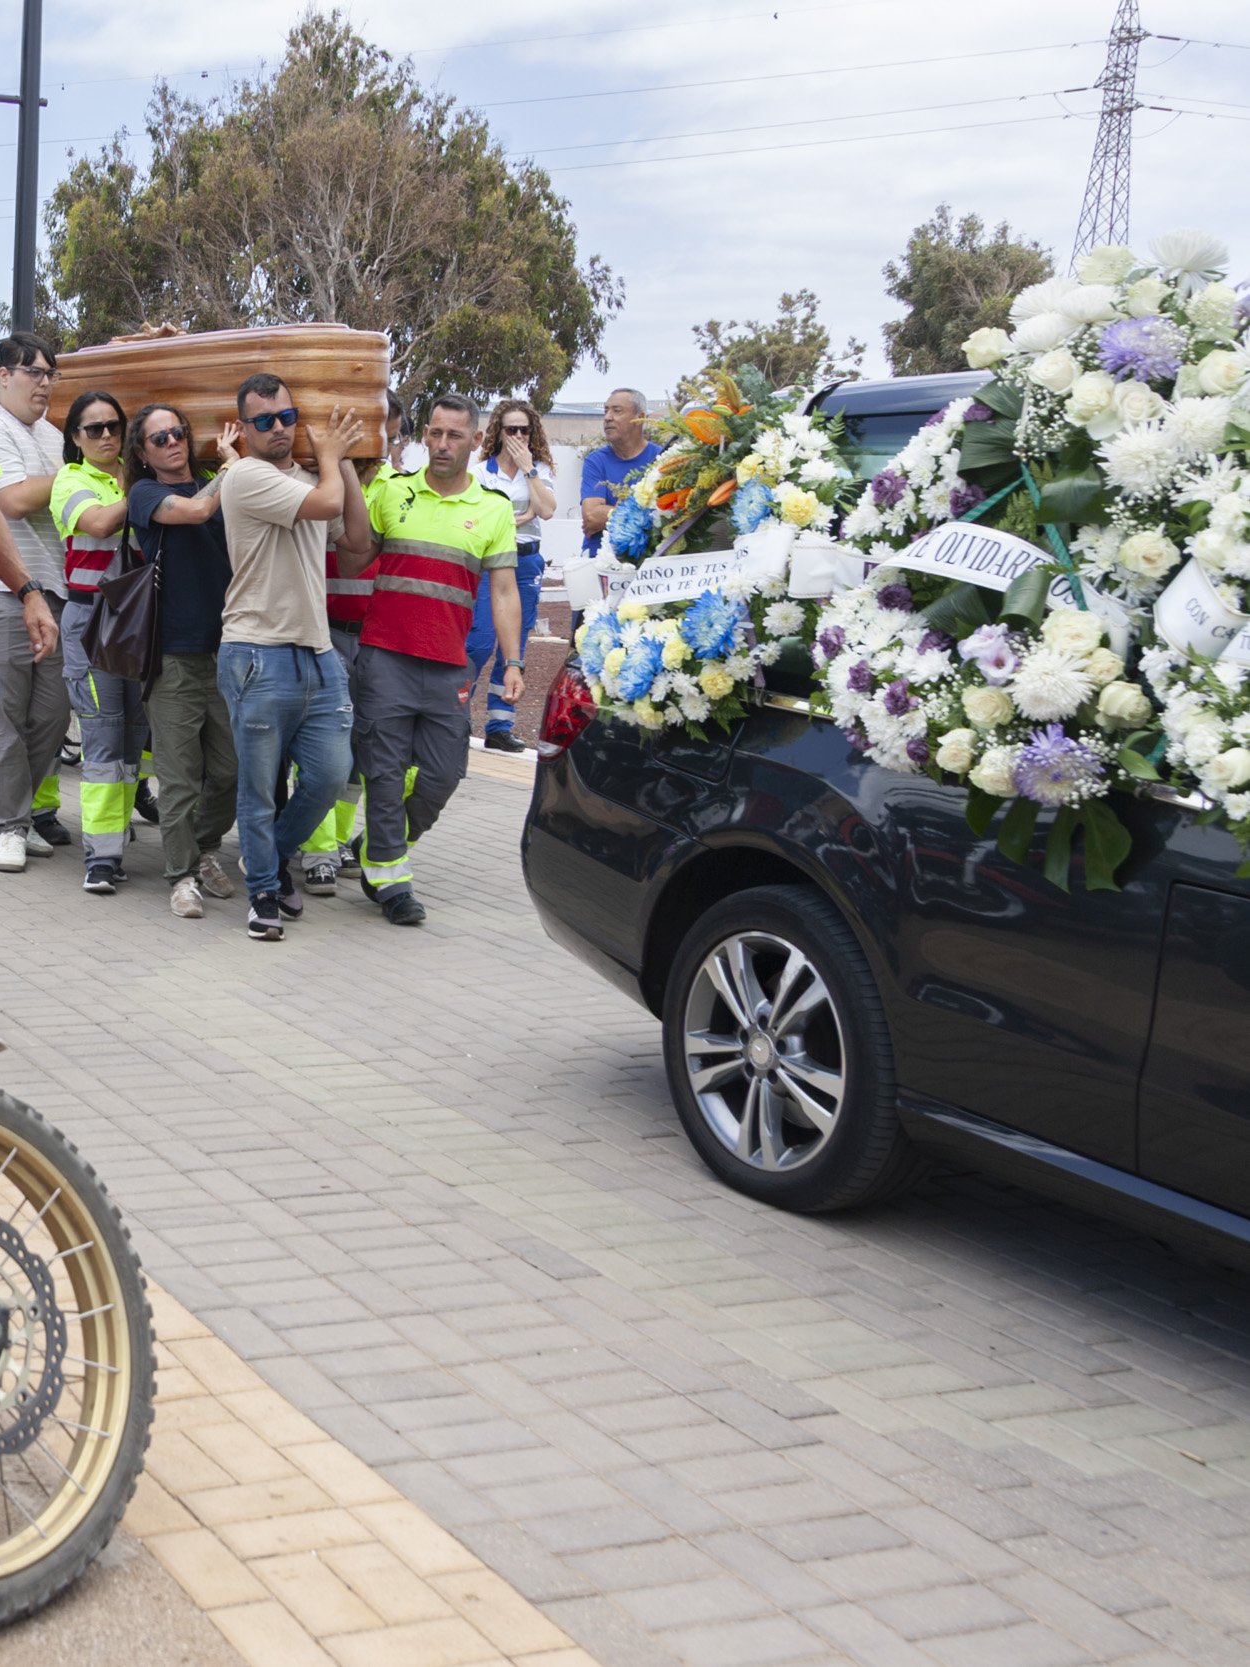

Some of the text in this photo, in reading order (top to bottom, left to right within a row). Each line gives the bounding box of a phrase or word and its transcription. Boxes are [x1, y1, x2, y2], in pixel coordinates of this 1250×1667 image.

[681, 565, 699, 577] DE
[705, 561, 728, 574] TUS
[677, 580, 693, 591] TE
[1186, 597, 1210, 626] CON
